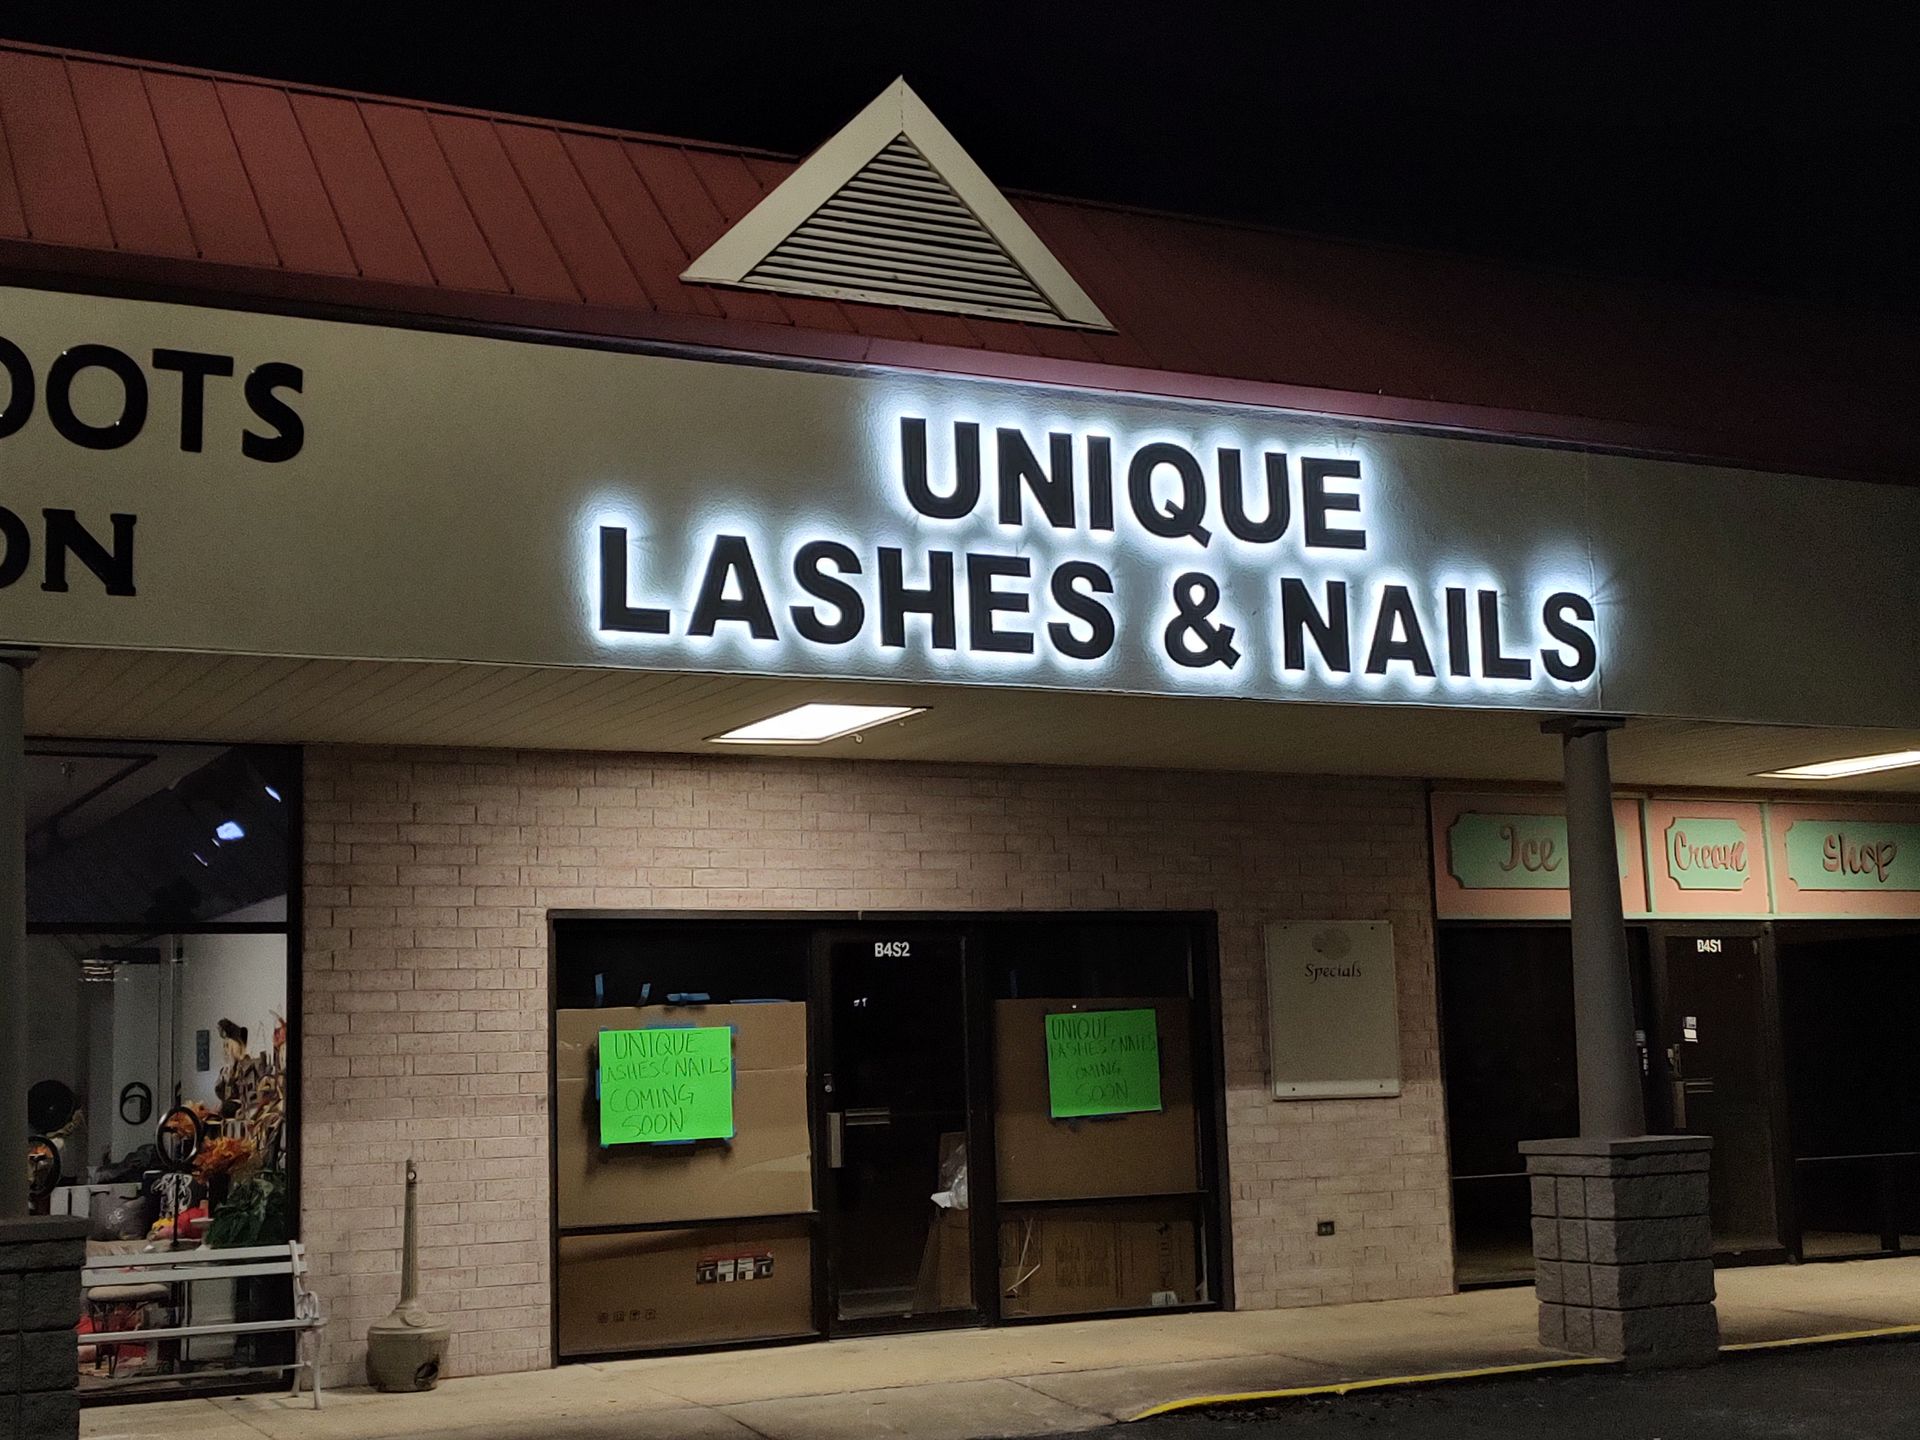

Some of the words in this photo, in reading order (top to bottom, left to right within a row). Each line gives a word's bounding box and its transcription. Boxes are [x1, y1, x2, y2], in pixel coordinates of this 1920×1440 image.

[900, 417, 1366, 550] UNIQUE
[600, 526, 1115, 659] LASHES
[1164, 572, 1241, 670] &
[1281, 577, 1596, 682] NAILS
[1500, 823, 1562, 872] Ice
[1674, 831, 1747, 872] Cream
[1823, 832, 1898, 882] Shop
[874, 942, 910, 957] B4S2
[1304, 962, 1362, 984] Specials
[615, 1031, 702, 1059] UNIQUE
[675, 1057, 729, 1077] NAILS
[609, 1084, 694, 1113] COMING
[622, 1107, 684, 1137] SOON
